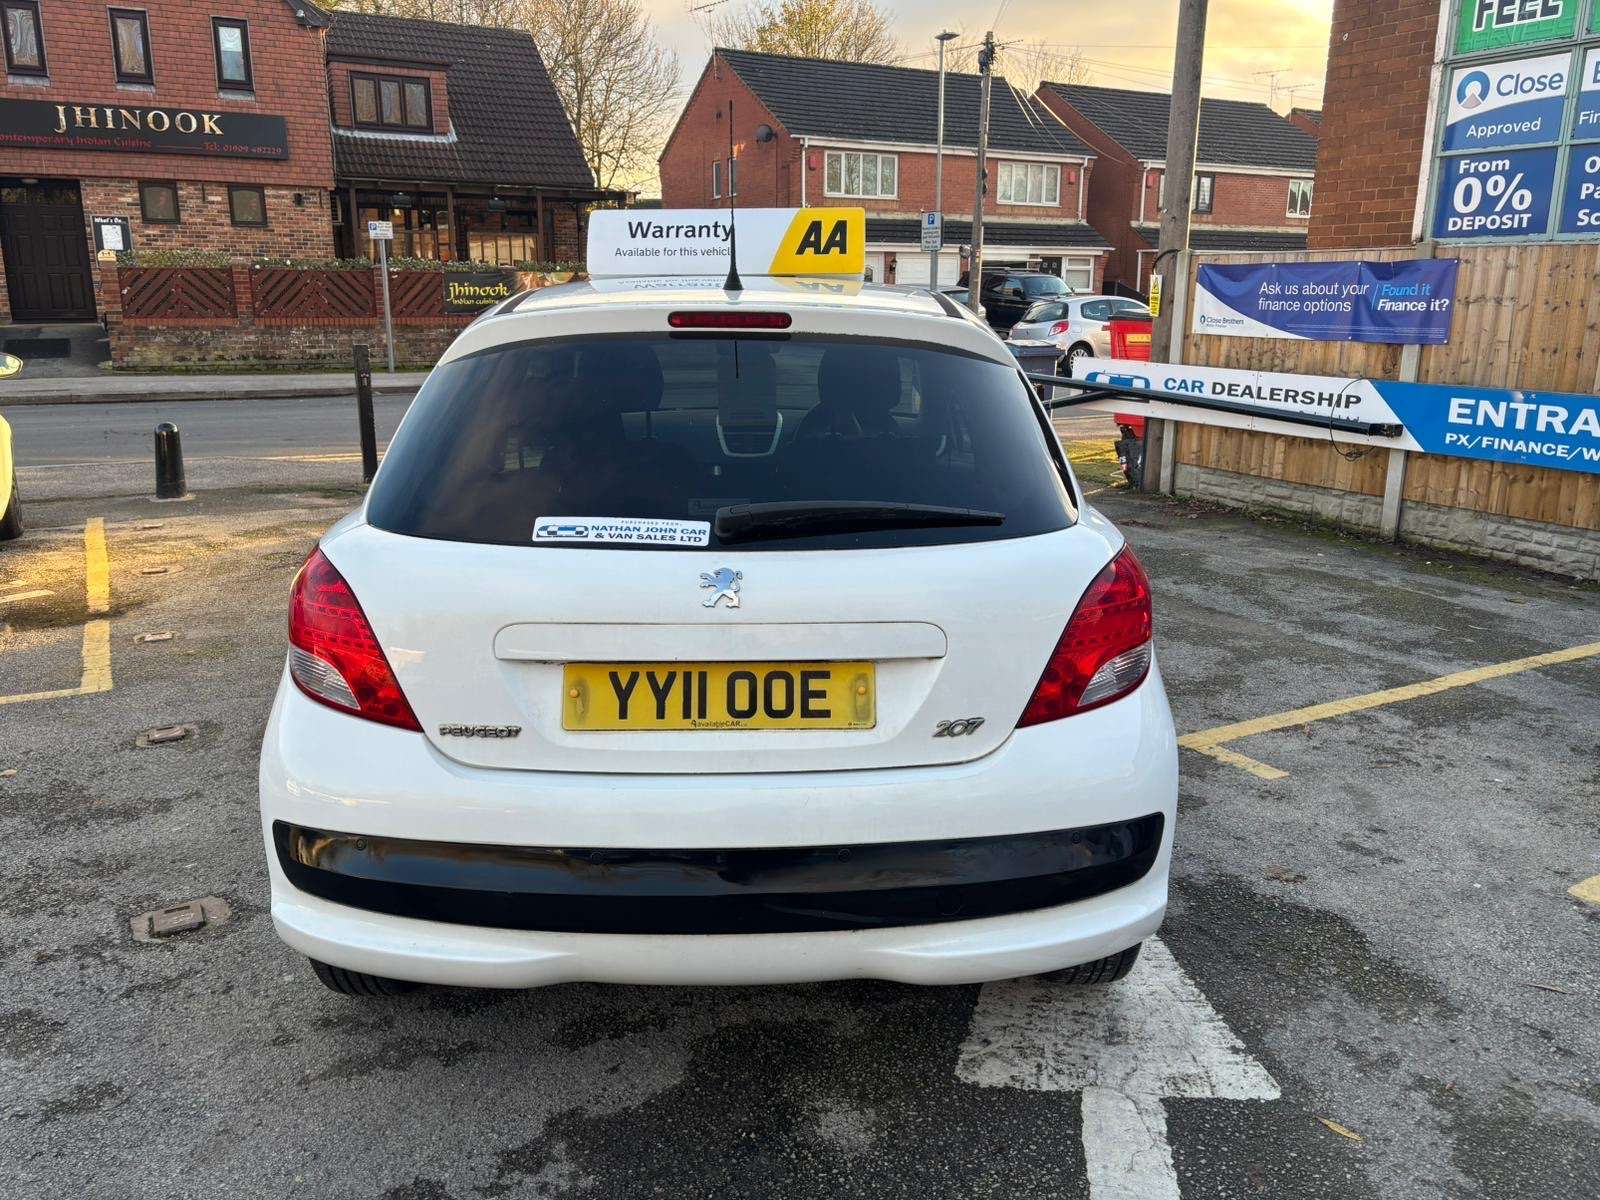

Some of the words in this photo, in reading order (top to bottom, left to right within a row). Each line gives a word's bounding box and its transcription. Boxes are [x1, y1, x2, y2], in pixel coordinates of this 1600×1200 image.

[1496, 72, 1563, 97] Close
[54, 104, 224, 135] JHINOOK
[1466, 117, 1542, 138] Approved
[1459, 159, 1510, 174] From
[1453, 173, 1532, 214] 0%
[1447, 213, 1532, 231] DEPOSIT
[628, 221, 732, 241] Warranty
[795, 220, 848, 255] AA
[615, 247, 661, 257] Available
[663, 247, 677, 256] for
[679, 247, 698, 256] this
[700, 247, 731, 256] vehicl
[447, 282, 511, 301] jhinook
[1258, 282, 1282, 295] Ask
[1284, 284, 1299, 295] us
[1302, 282, 1338, 295] about
[1341, 283, 1369, 298] your
[1381, 283, 1418, 296] Found
[1421, 283, 1430, 295] it
[1258, 299, 1300, 311] finance
[1303, 299, 1351, 314] options
[1377, 299, 1426, 311] Finance
[1430, 299, 1449, 311] it?
[1163, 377, 1204, 393] CAR
[1211, 382, 1362, 409] DEALERSHIP
[1448, 398, 1600, 437] ENTRA
[591, 525, 641, 533] NATHAN
[637, 533, 676, 541] SALES
[608, 670, 708, 720] YY11
[726, 670, 831, 719] OOE
[439, 724, 522, 738] PEUGEOT
[932, 716, 986, 737] 207
